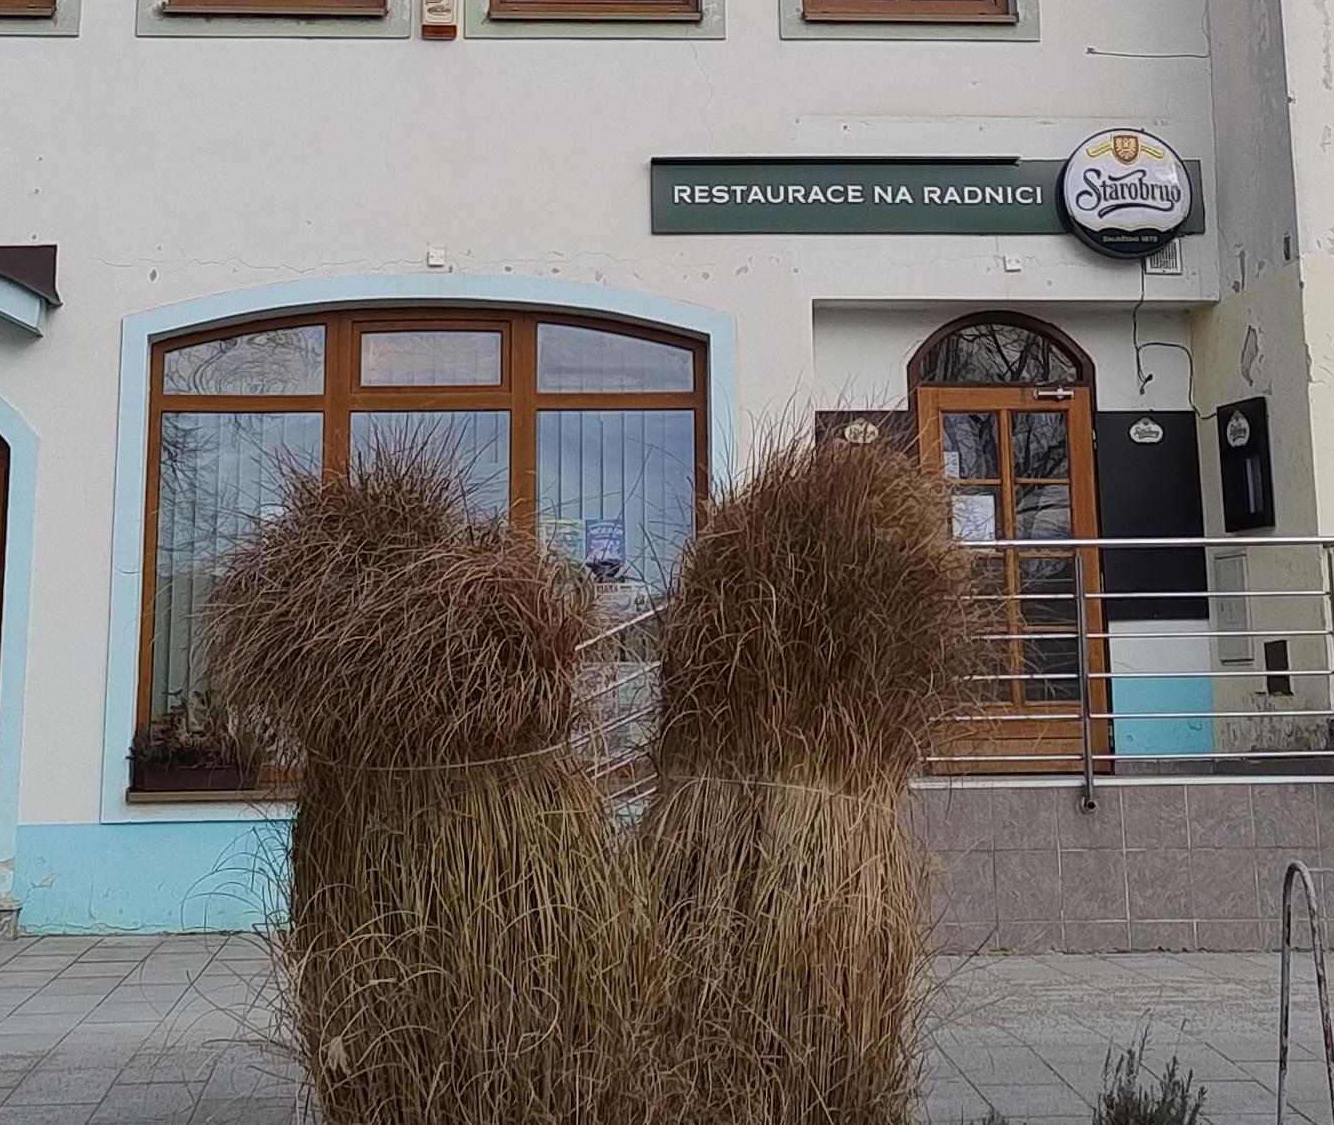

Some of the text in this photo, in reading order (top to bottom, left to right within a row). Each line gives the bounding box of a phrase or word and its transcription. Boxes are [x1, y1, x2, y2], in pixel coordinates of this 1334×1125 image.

[673, 185, 1043, 205] RESTAURACE NA RADNICI
